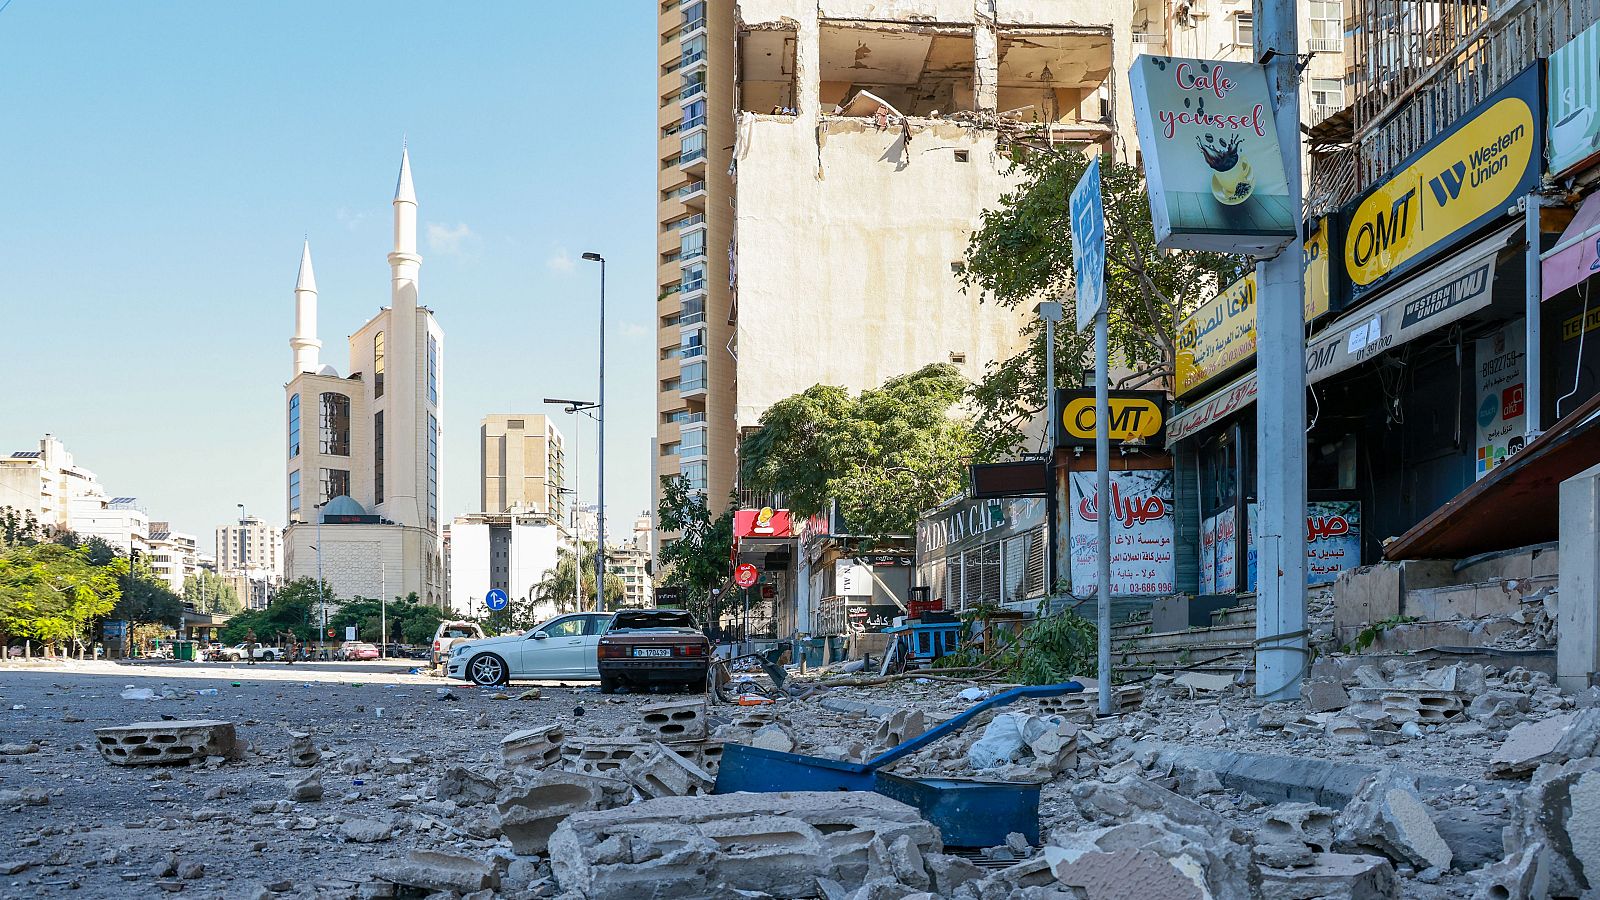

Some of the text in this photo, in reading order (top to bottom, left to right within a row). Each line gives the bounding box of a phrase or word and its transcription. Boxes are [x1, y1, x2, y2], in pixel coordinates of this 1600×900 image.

[1176, 63, 1237, 98] Cafe
[1159, 104, 1266, 139] youssef
[1468, 123, 1524, 170] Western
[1470, 153, 1508, 188] Union
[1354, 187, 1415, 268] OMT
[1406, 285, 1451, 315] WESTERN
[1455, 269, 1485, 301] WU
[1417, 297, 1449, 319] UNION
[1179, 304, 1223, 350] للصيرفة
[1306, 339, 1341, 374] OMT
[1357, 349, 1364, 361] 01
[1366, 343, 1377, 357] 391
[1075, 405, 1149, 431] OMT
[924, 510, 965, 552] ADNAN
[1311, 563, 1342, 574] العربية
[1318, 548, 1345, 560] تبديل
[1130, 583, 1156, 593] 03-686
[1158, 582, 1172, 593] 996
[866, 613, 889, 629] كافيه
